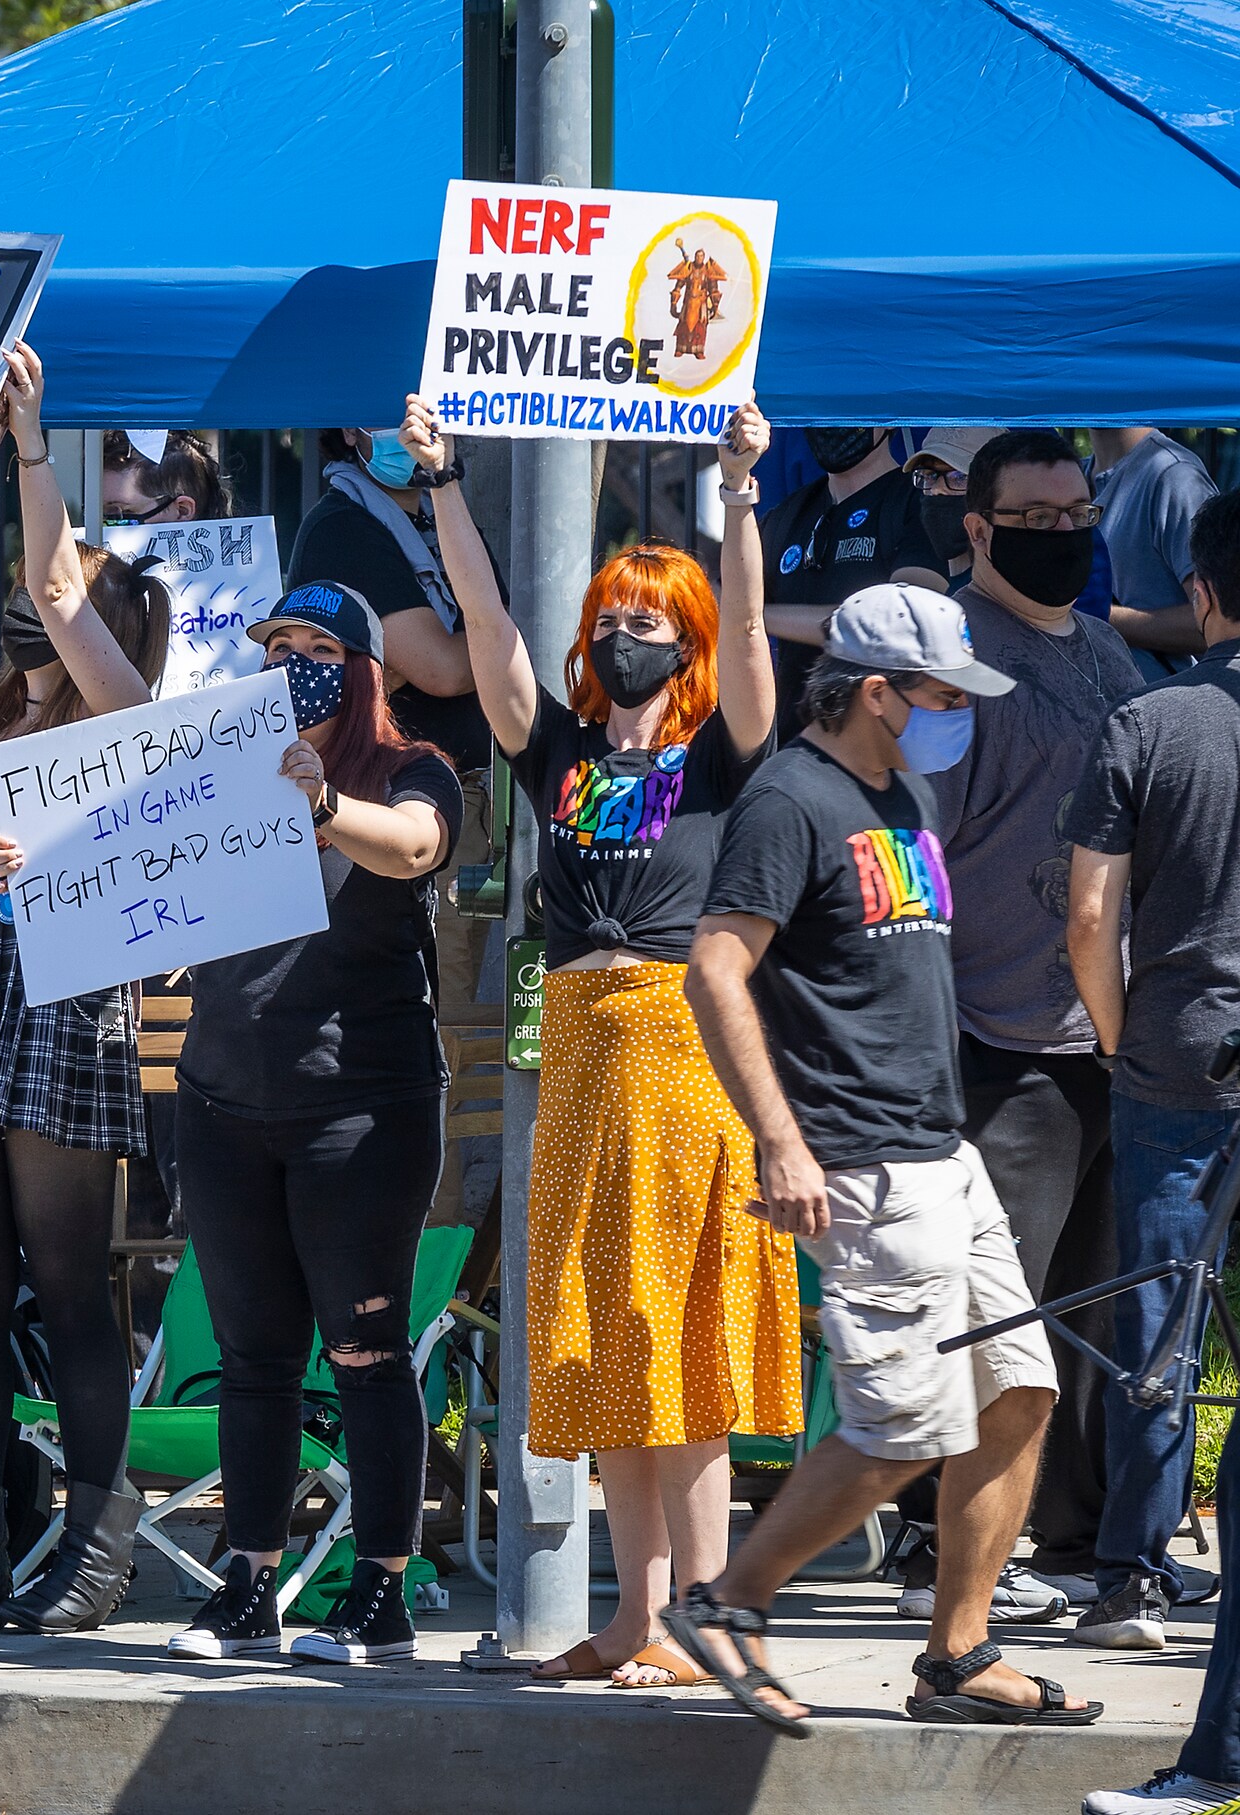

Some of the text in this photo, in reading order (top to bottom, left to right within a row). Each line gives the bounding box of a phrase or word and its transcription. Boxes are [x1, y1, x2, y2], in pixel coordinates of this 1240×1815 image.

[468, 198, 611, 255] NERF
[465, 272, 593, 317] MALE
[443, 327, 664, 384] PRIVILEGE
[171, 605, 245, 635] sation
[0, 698, 288, 816] FIGHT BAD GUYS
[86, 773, 217, 841] IN GAME
[14, 856, 122, 923] FIGHT
[132, 833, 209, 881] BAD
[220, 817, 304, 858] GUYS
[120, 895, 205, 945] IRL
[513, 993, 543, 1008] PUSH
[515, 1025, 541, 1039] GREE
